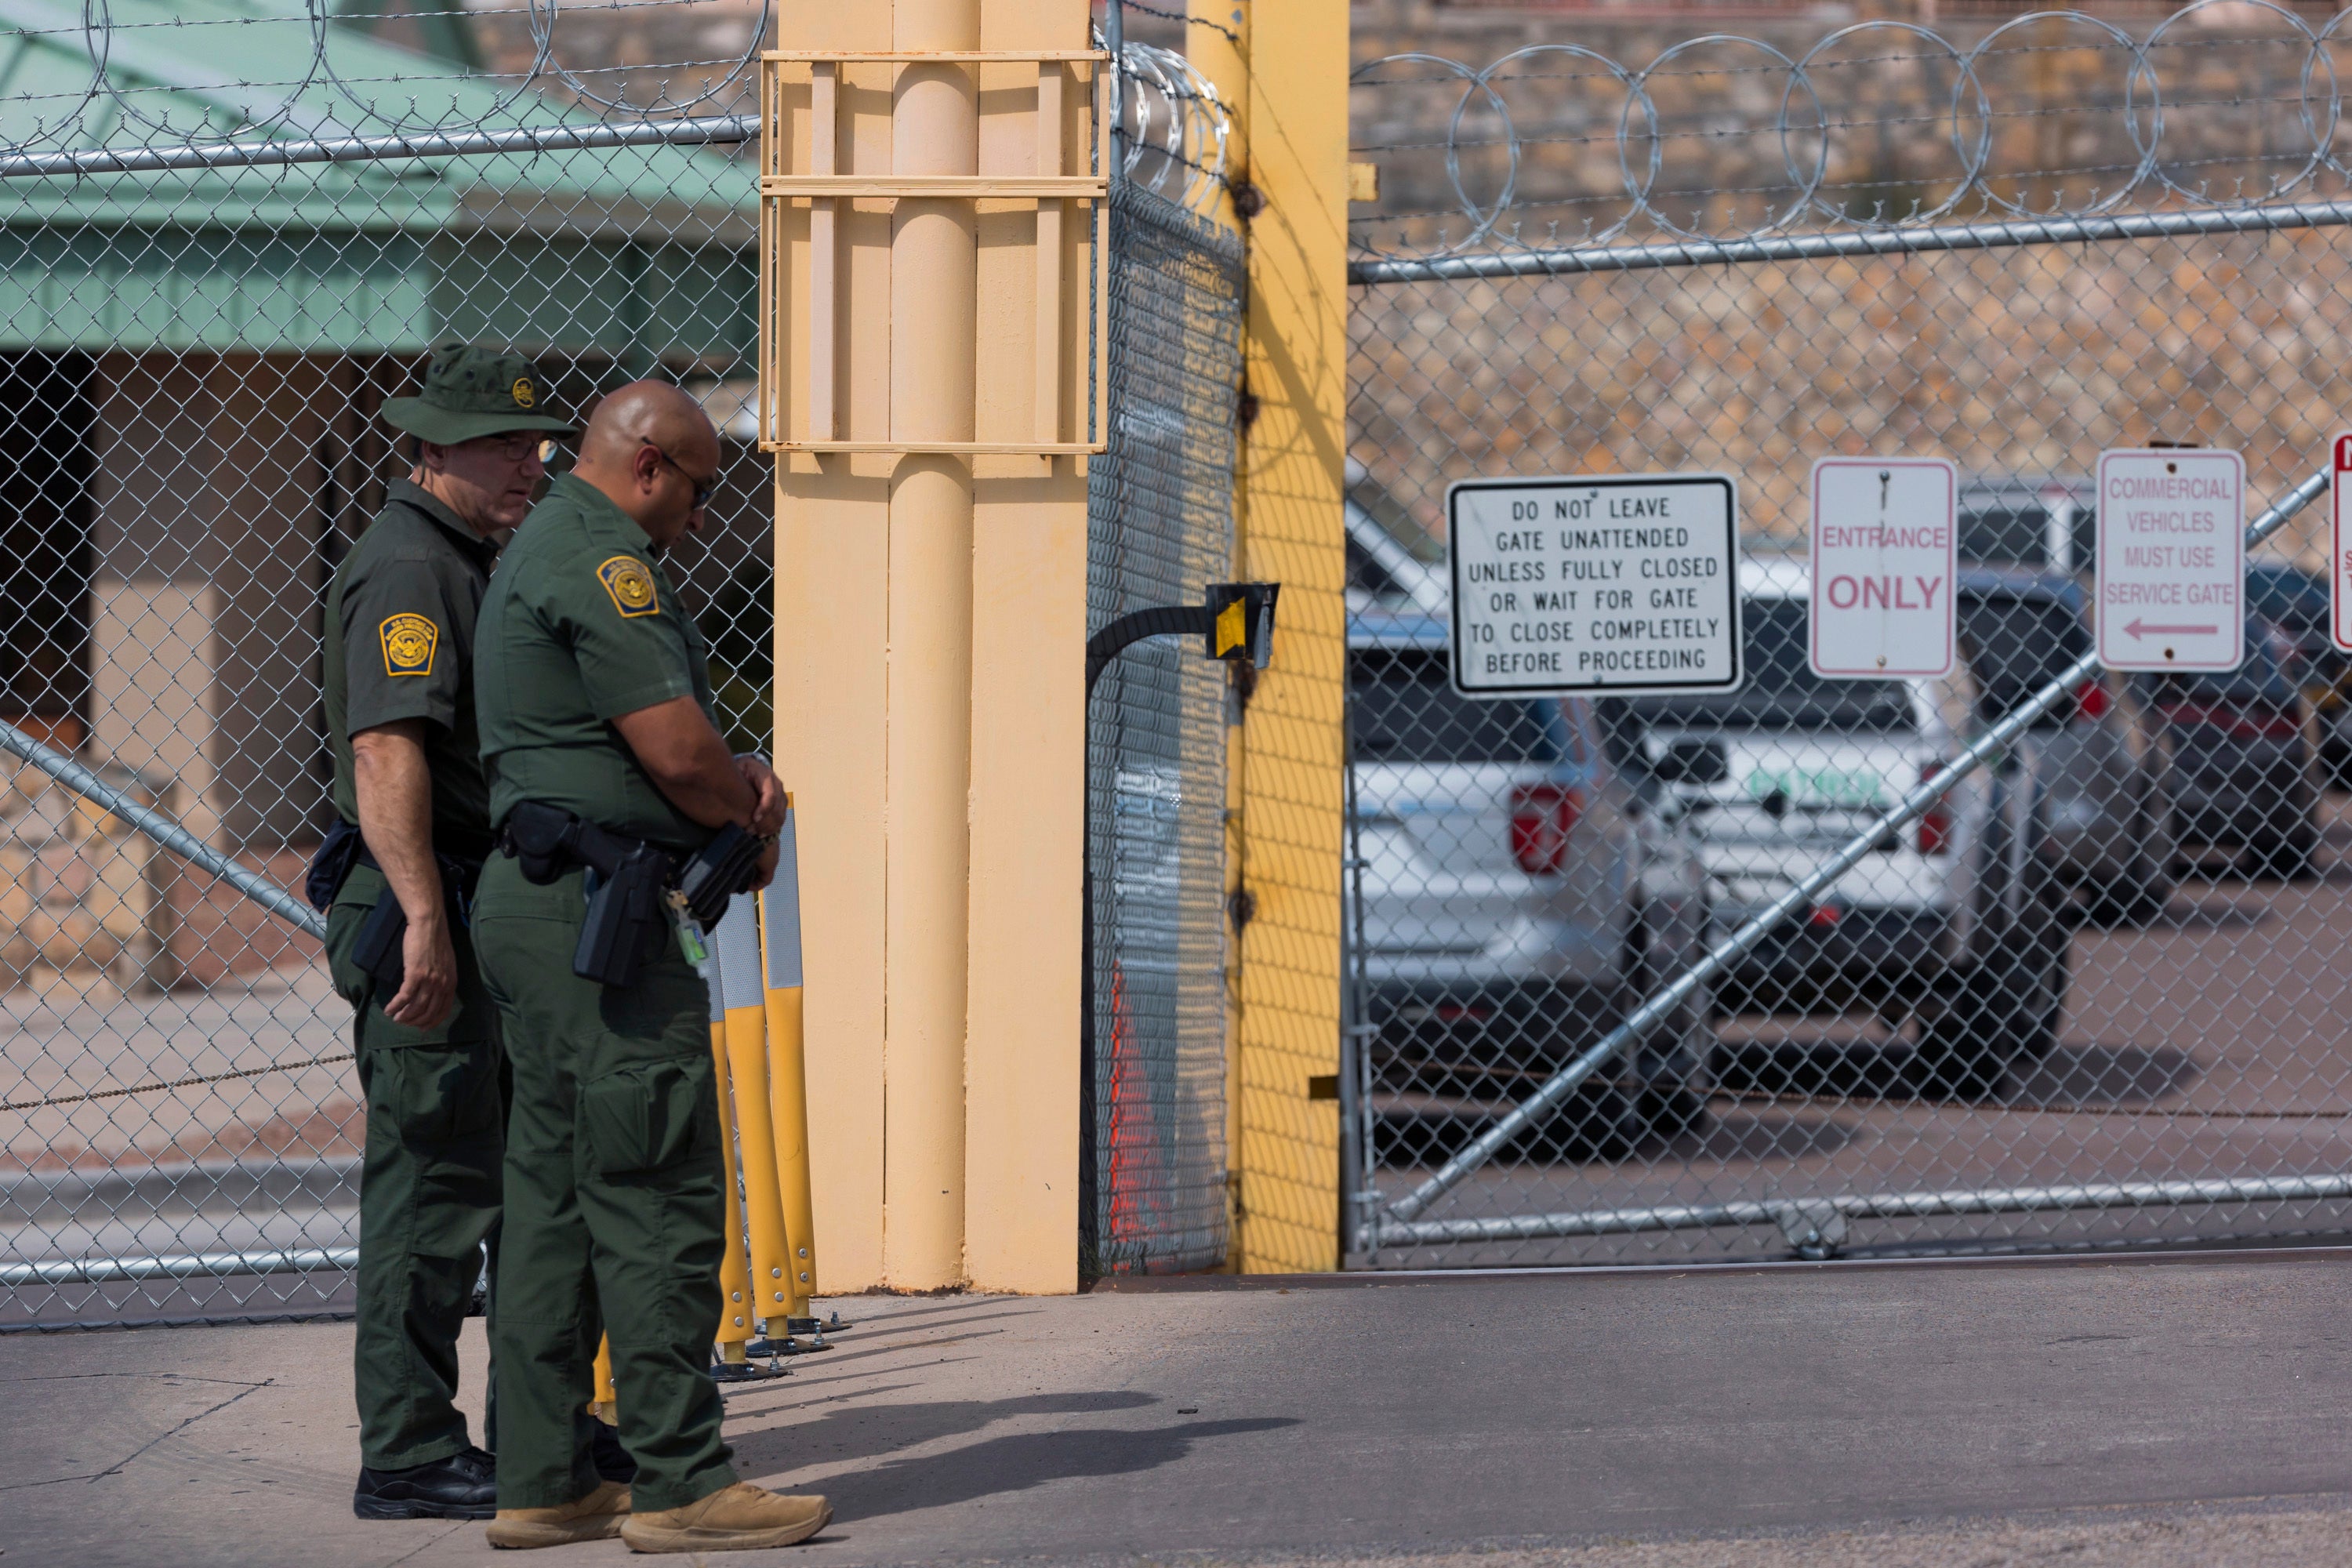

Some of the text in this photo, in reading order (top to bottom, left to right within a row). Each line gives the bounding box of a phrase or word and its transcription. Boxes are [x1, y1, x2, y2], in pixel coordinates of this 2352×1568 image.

[2109, 477, 2231, 500] COMMERCIAL
[1513, 498, 1670, 521] DO NOT LEAVE
[2126, 511, 2214, 532] VEHICLES
[1497, 528, 1689, 551] GATE UNATTENDED
[1823, 527, 1947, 548] ENTRANCE
[2125, 546, 2214, 567] MUST USE
[1469, 558, 1717, 583] UNLESS FULLY CLOSED
[1490, 588, 1697, 612] OR WAIT FOR GATE
[1828, 575, 1942, 609] ONLY
[2107, 584, 2234, 604] SERVICE GATE
[1472, 619, 1719, 643] TO CLOSE COMPLETELY
[1486, 649, 1705, 673] BEFORE PROCEEDING
